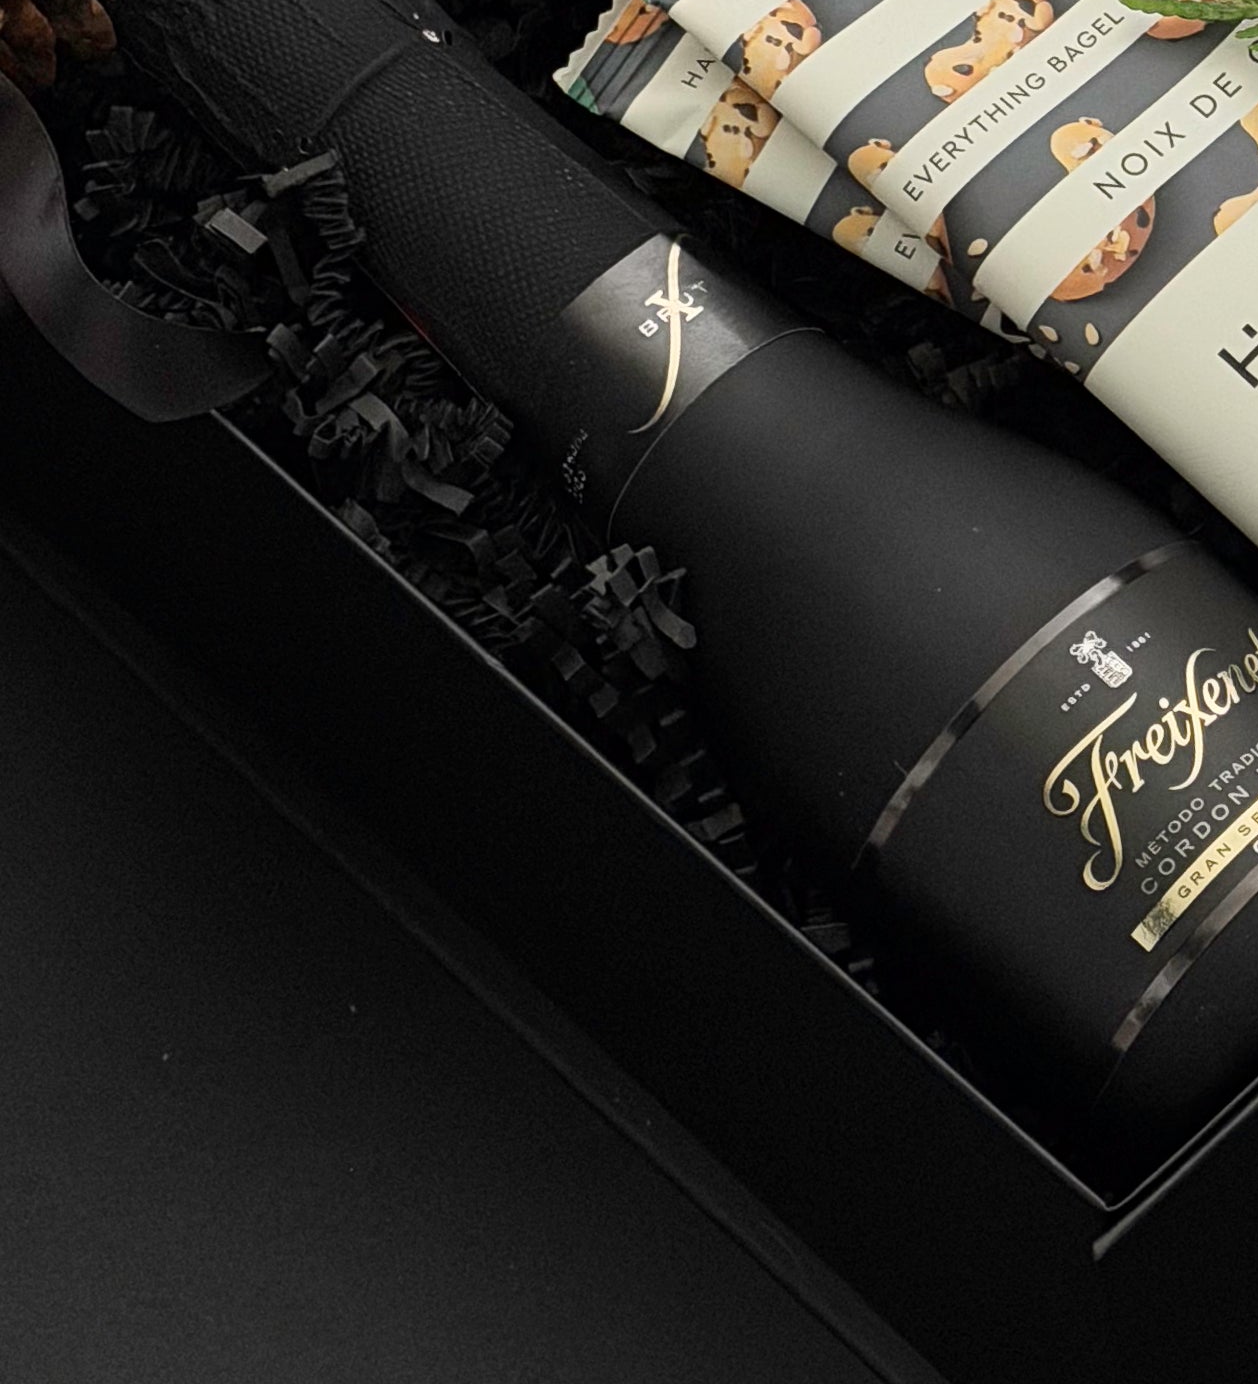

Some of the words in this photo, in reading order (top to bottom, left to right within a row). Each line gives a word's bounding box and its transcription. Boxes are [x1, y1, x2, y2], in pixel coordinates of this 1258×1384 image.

[681, 50, 718, 89] HA
[903, 72, 1046, 203] EVERYTHING
[1047, 10, 1126, 74] BAGEL
[1092, 120, 1187, 201] NOIX
[1189, 71, 1243, 119] DE
[1140, 786, 1250, 896] CORDON
[1177, 842, 1232, 900] GRAN
